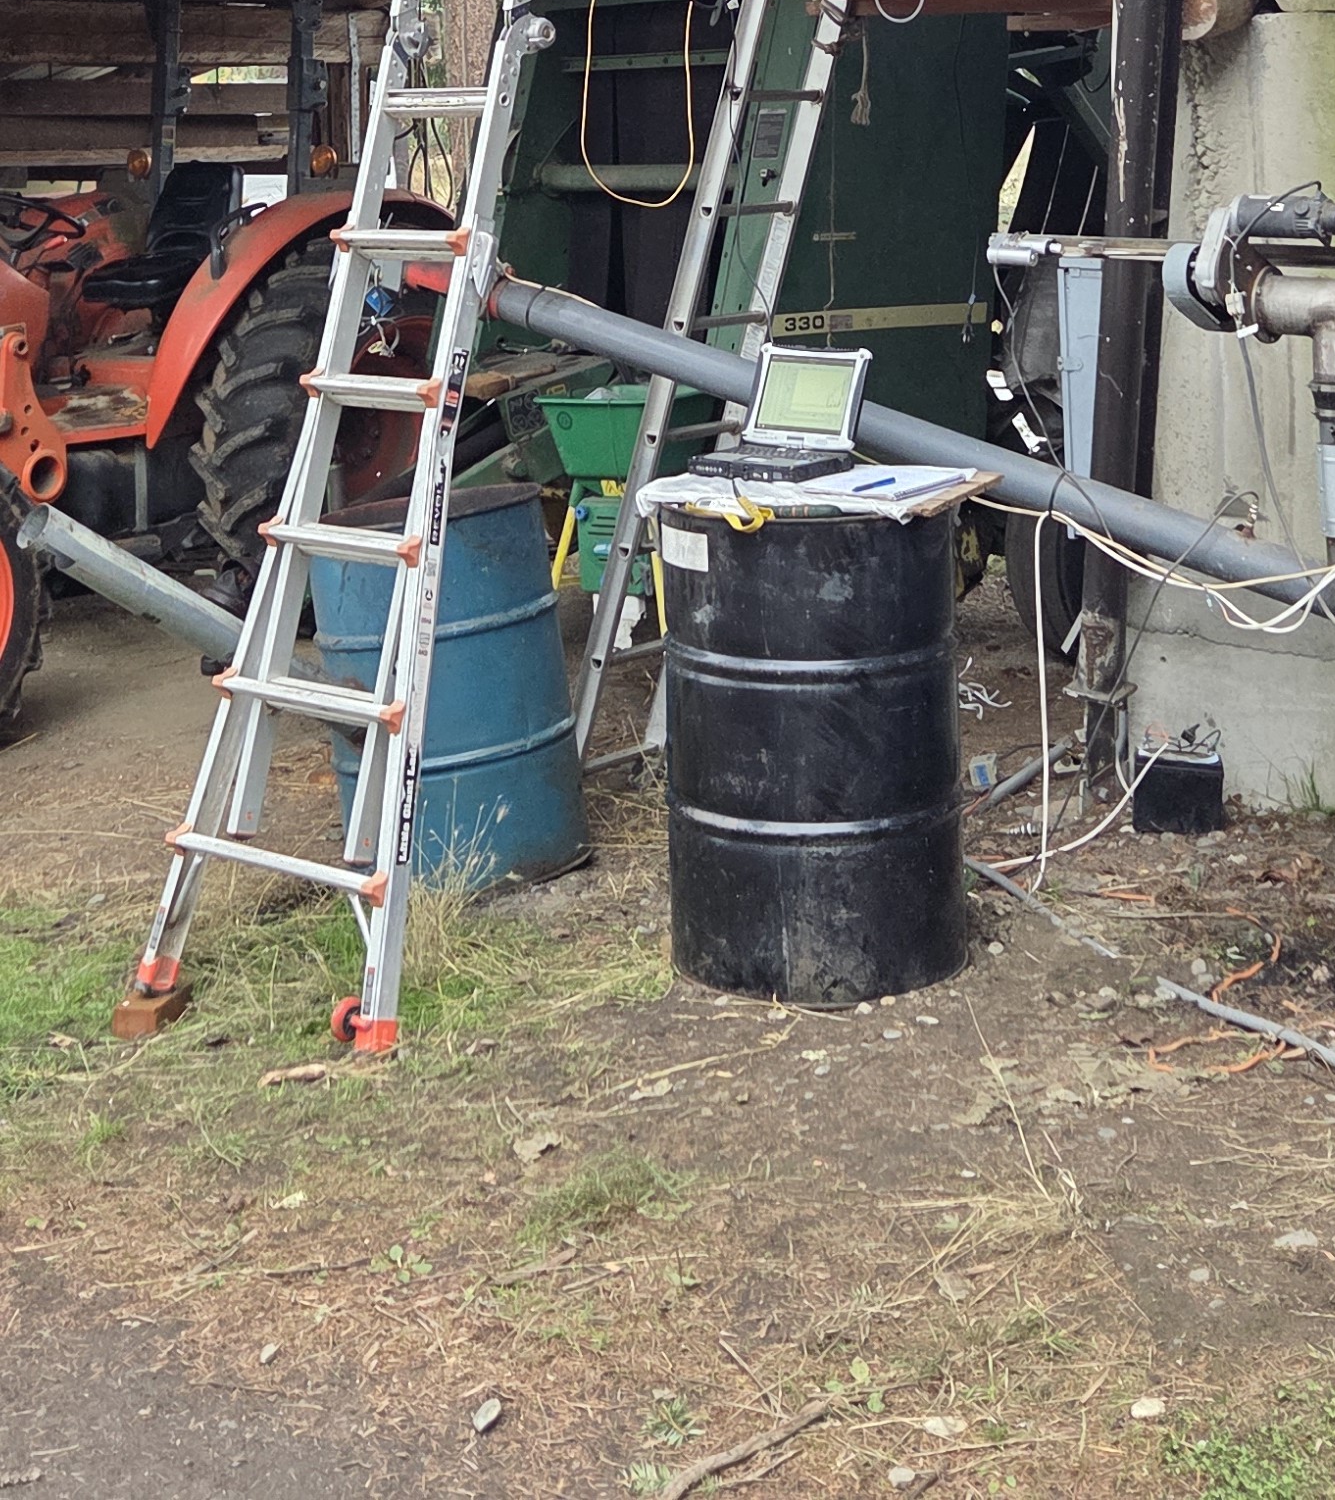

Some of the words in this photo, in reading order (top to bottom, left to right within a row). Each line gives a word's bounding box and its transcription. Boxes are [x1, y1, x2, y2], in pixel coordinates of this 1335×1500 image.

[785, 315, 825, 332] 330
[402, 779, 415, 820] Giant
[398, 821, 411, 863] Little
